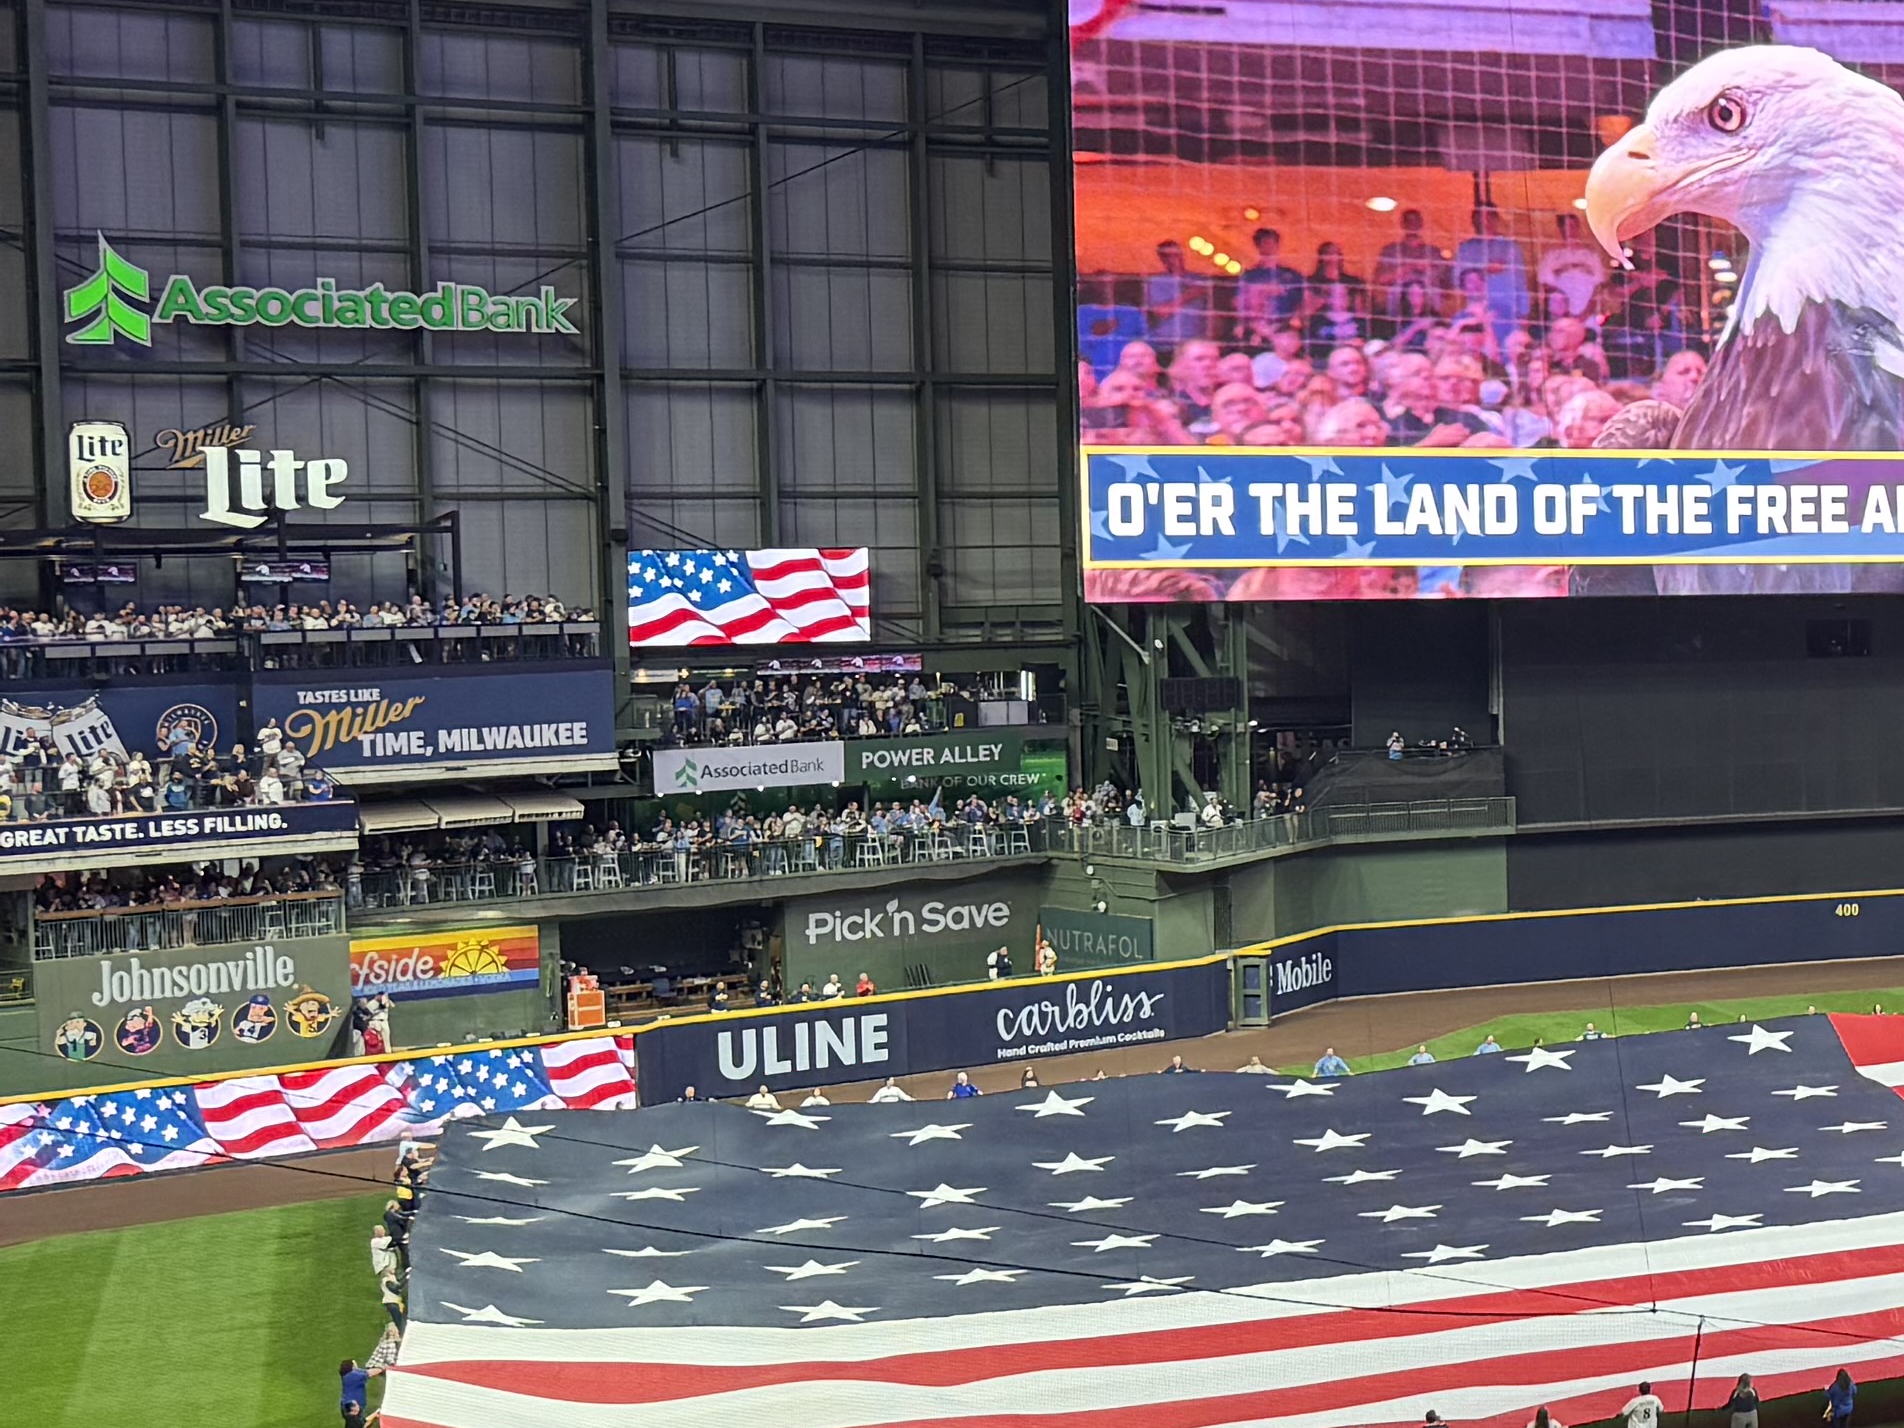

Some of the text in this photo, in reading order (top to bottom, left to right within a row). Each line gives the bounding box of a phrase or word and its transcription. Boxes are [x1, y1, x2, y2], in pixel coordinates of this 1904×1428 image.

[76, 433, 124, 462] Lite
[156, 424, 256, 469] Miller
[197, 446, 349, 529] Lite
[1106, 481, 1236, 538] O'ER
[1249, 482, 1358, 537] THE
[1374, 482, 1519, 536] LAND
[1532, 483, 1601, 535] OF
[1613, 483, 1714, 535] THE
[1726, 483, 1849, 535] FREE
[297, 687, 381, 705] TASTES LIKE
[65, 719, 113, 758] Lite
[285, 695, 426, 758] Miller
[357, 722, 589, 758] TIME, MILWAUKEE
[861, 743, 1003, 770] POWER ALLEY
[944, 776, 963, 789] OF
[966, 775, 996, 788] OUR
[999, 773, 1040, 786] CREW
[0, 813, 288, 849] GREAT TASTE. LESS FILLING.
[920, 899, 1011, 933] Save
[1835, 903, 1859, 917] 400
[1047, 926, 1143, 959] NUTRAFOL
[92, 945, 296, 1007] Johnsonville
[1276, 952, 1332, 995] Mobile
[996, 979, 1165, 1041] carbliss
[717, 1013, 890, 1080] ULINE
